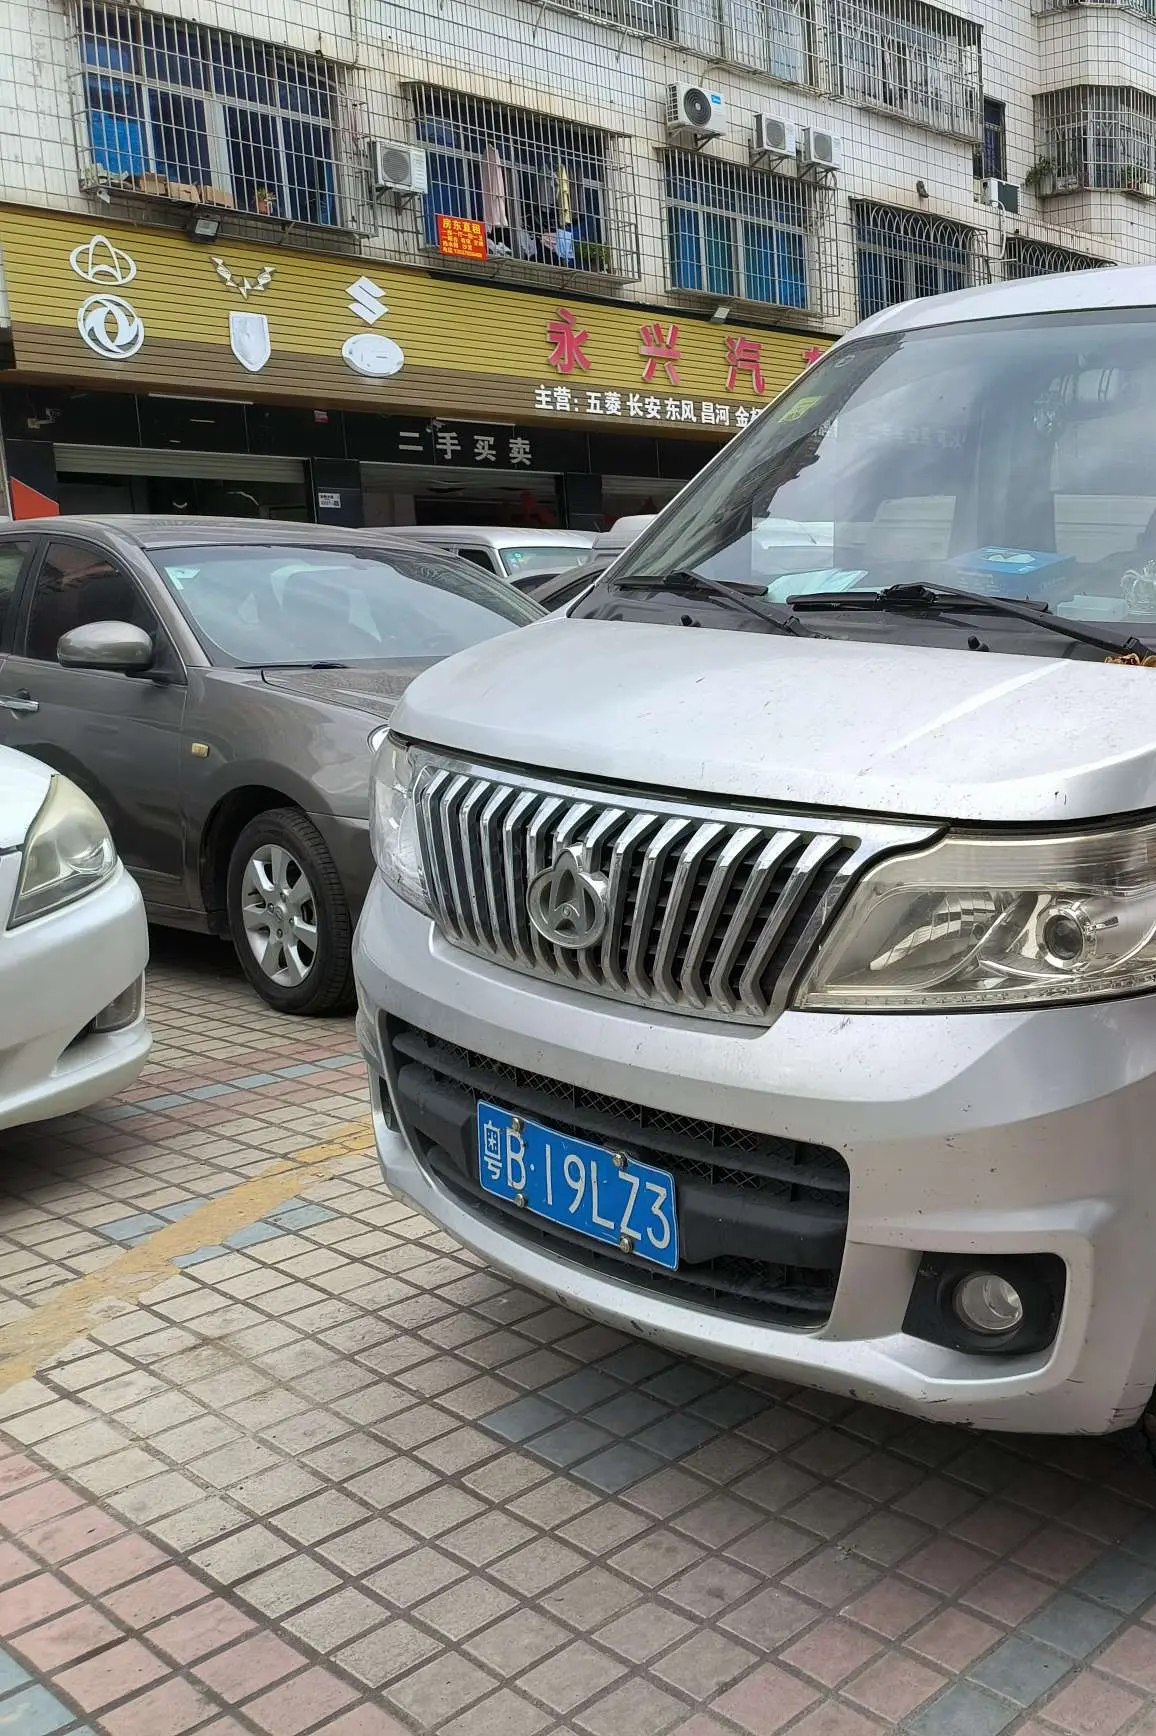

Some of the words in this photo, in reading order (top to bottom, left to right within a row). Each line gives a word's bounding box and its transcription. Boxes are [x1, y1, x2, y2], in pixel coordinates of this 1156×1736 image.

[547, 308, 826, 395] 永兴汽
[398, 431, 532, 466] 二手买卖
